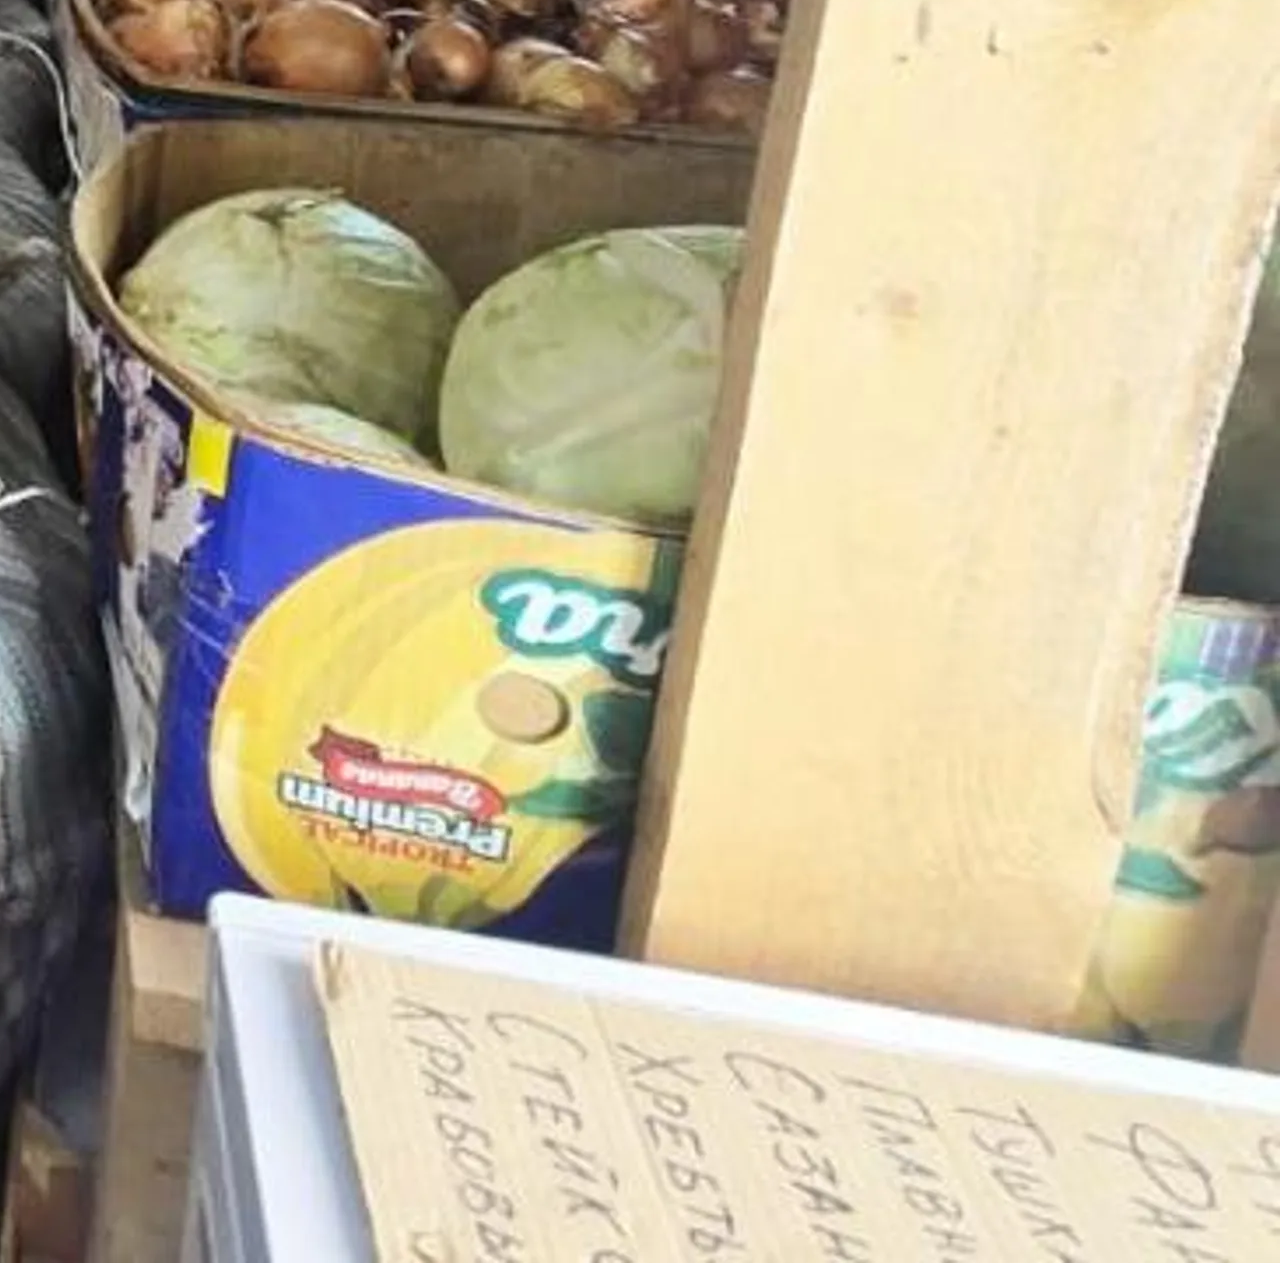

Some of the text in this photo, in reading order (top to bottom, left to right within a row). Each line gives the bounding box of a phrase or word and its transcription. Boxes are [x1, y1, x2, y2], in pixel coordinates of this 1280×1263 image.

[278, 772, 513, 863] Premium
[299, 814, 474, 874] TROPICAL
[485, 1009, 630, 1239] СТЕЙК
